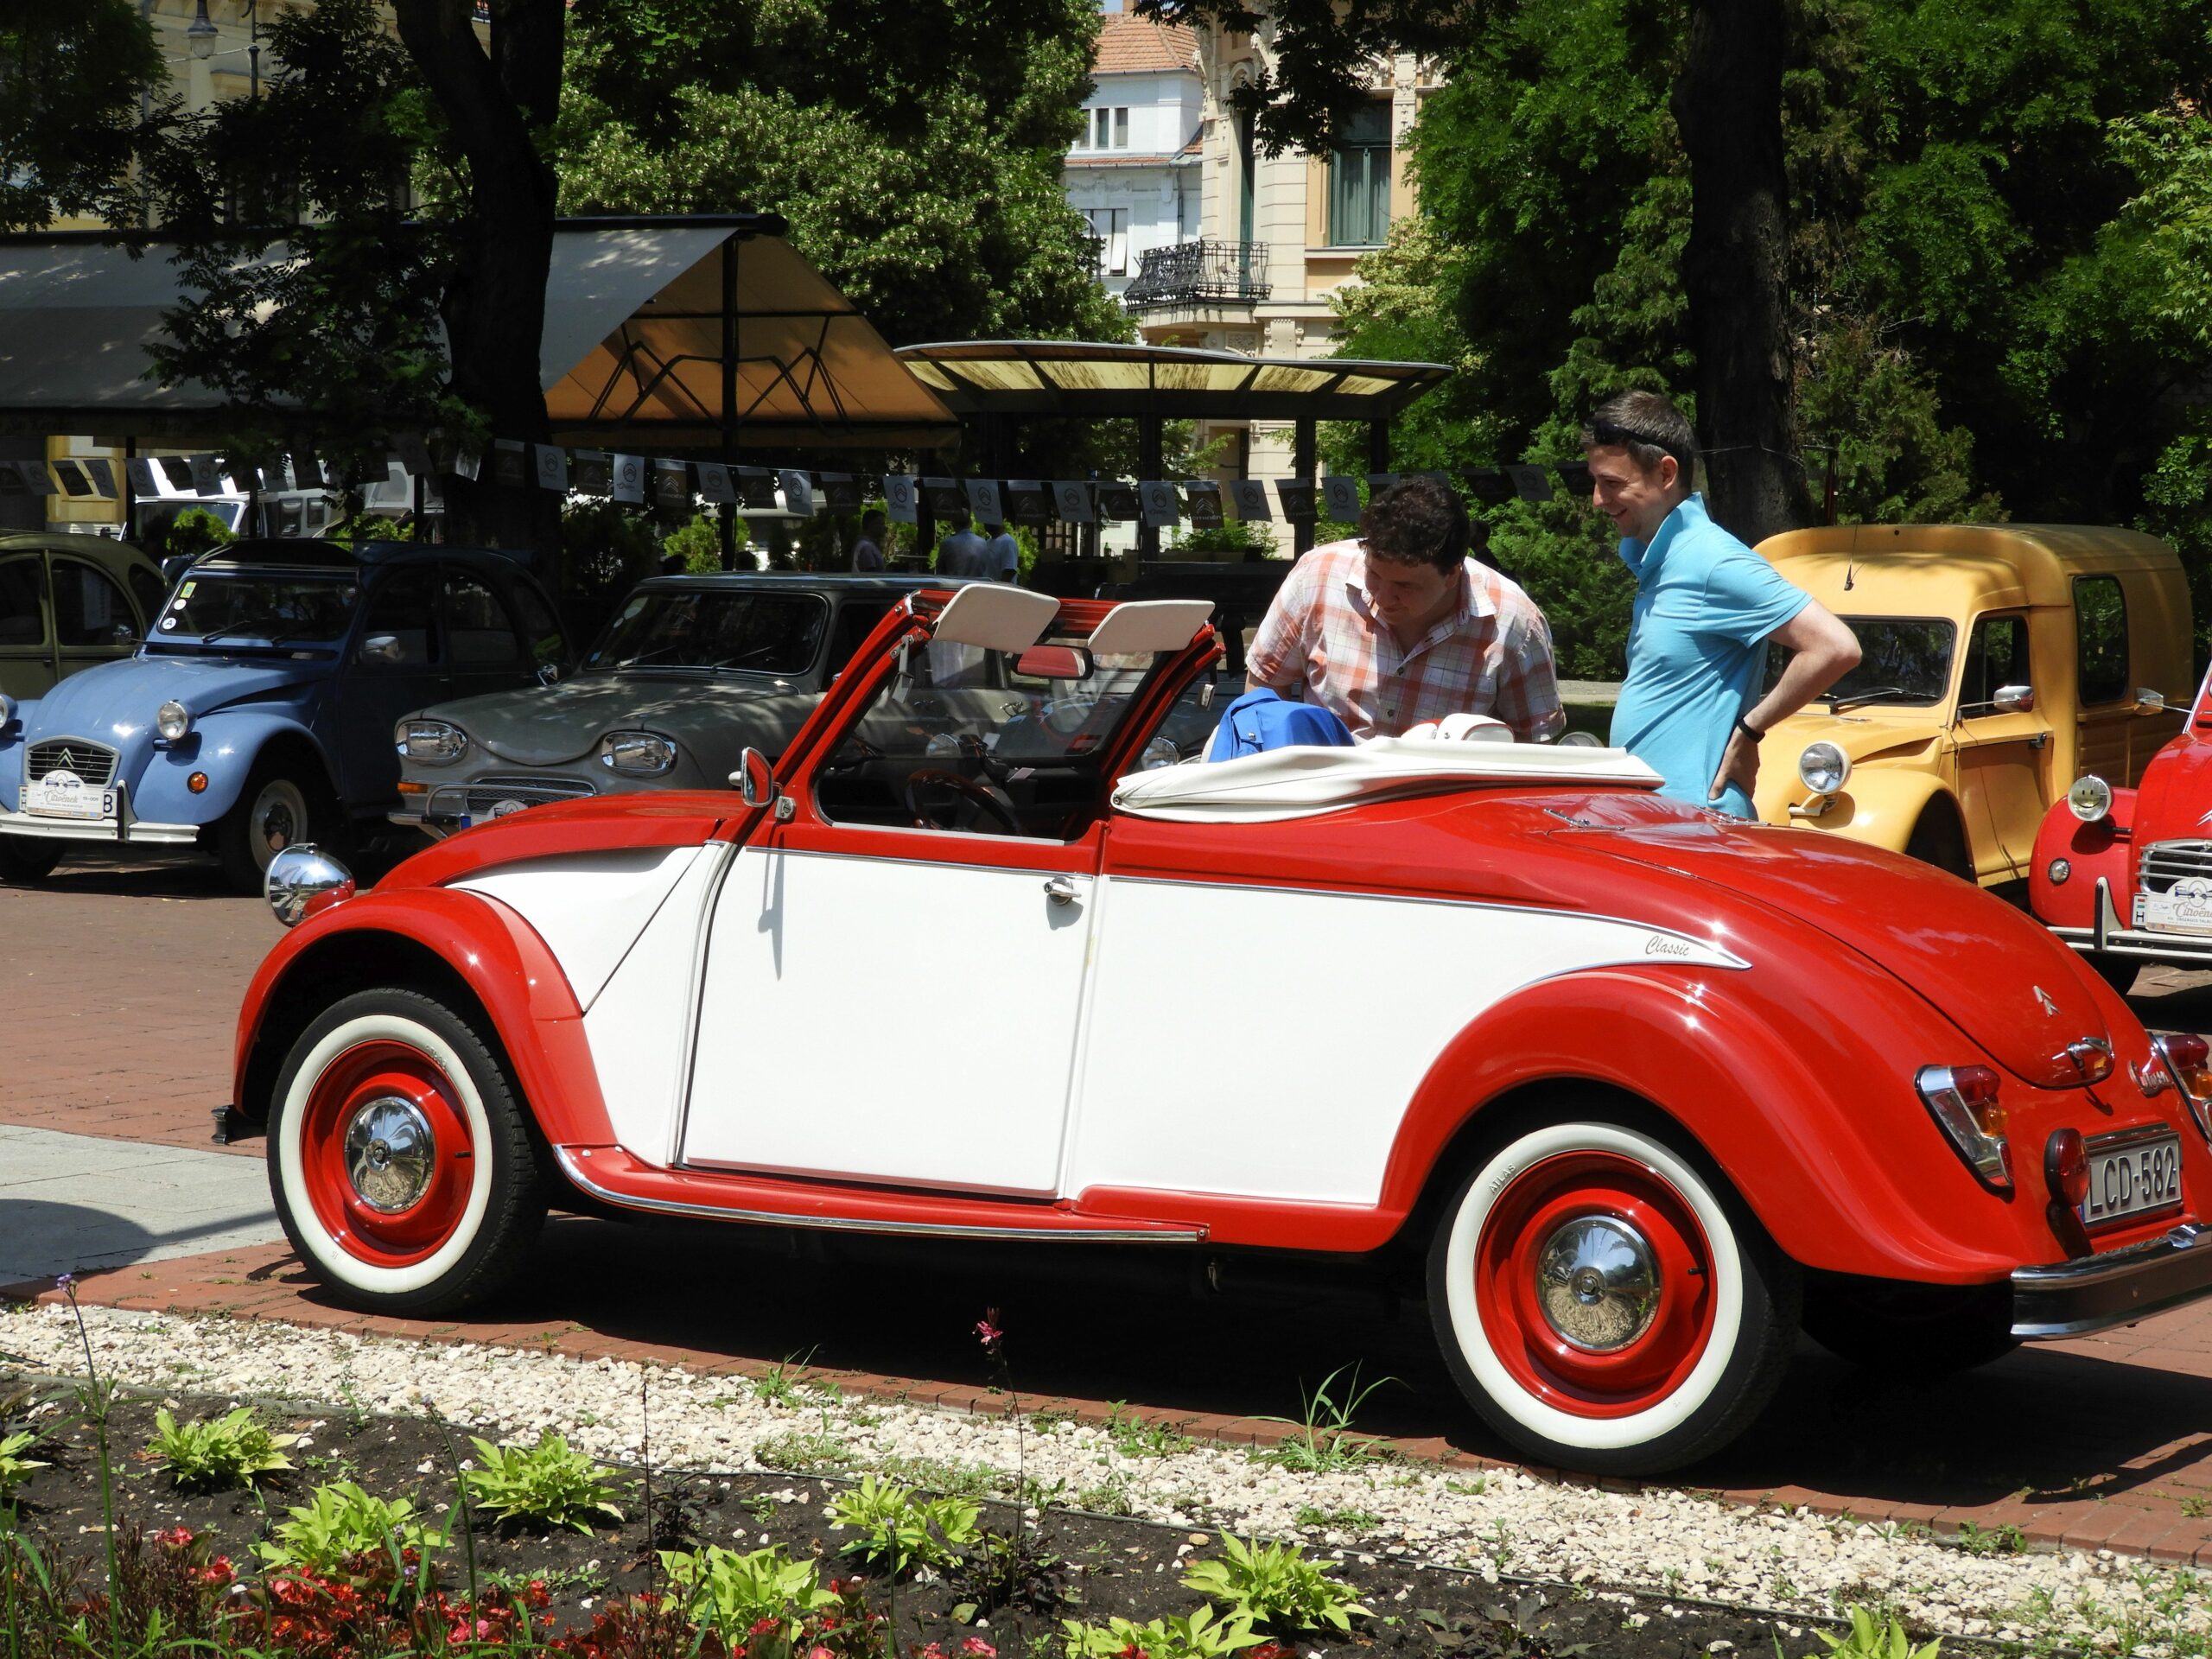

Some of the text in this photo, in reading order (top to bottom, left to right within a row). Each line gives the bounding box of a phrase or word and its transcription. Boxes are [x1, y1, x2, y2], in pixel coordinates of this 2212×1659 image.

[2136, 912, 2145, 923] H
[1644, 935, 1690, 957] Classic
[1489, 1163, 1516, 1194] ATLAS
[2089, 1145, 2177, 1215] LCD-582
